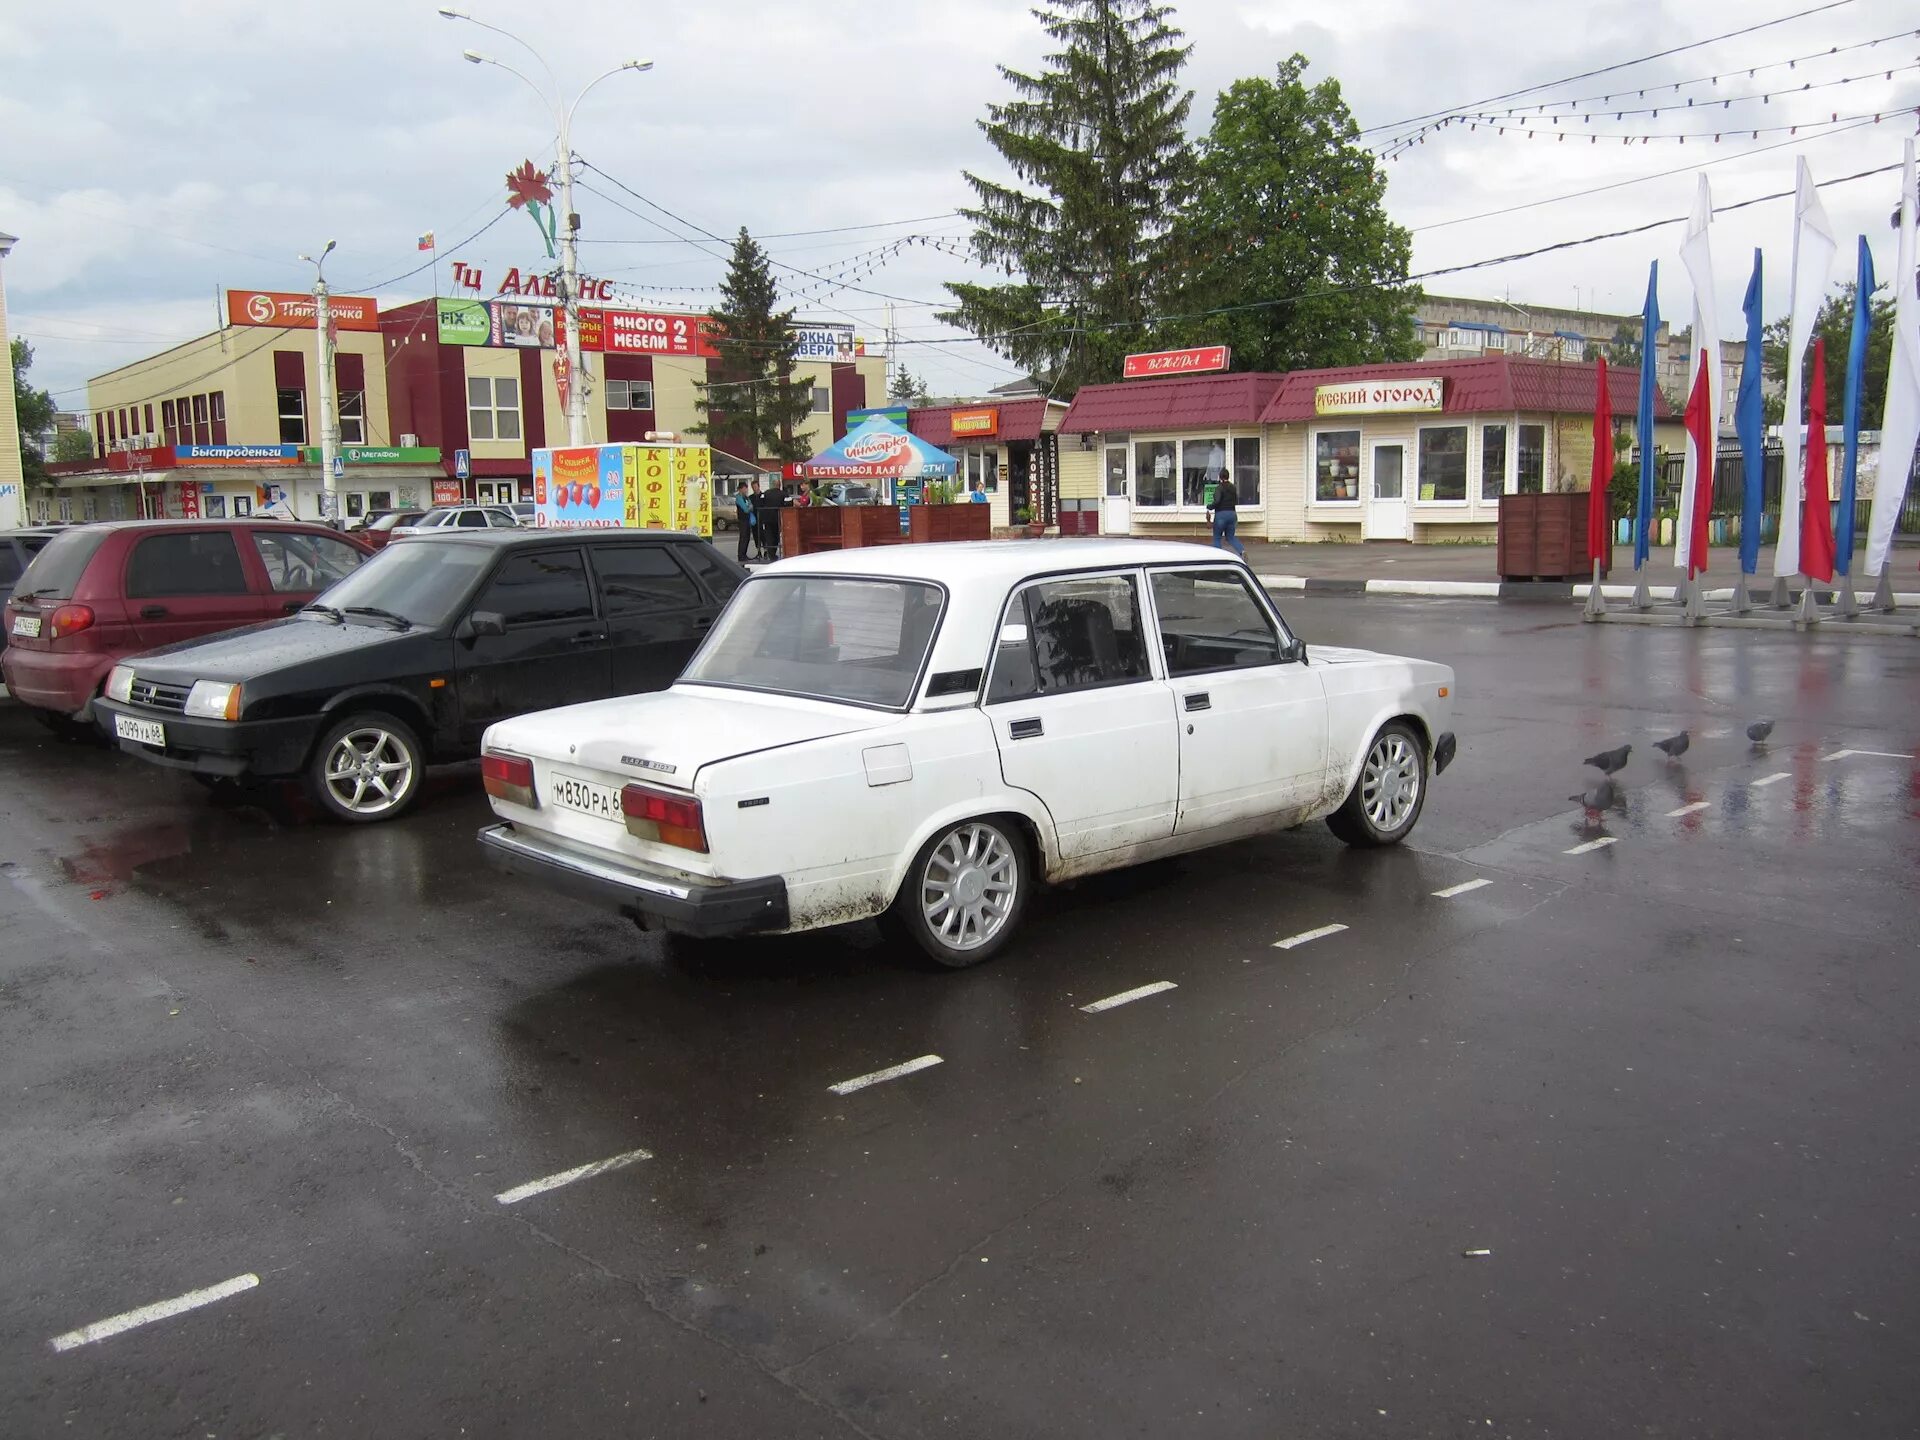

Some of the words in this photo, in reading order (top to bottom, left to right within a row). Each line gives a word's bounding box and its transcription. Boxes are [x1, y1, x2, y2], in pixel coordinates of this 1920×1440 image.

[453, 262, 483, 291] ТЦ
[497, 267, 614, 301] АЛЬНС
[440, 312, 465, 325] FIX
[613, 315, 667, 333] МНОГО
[673, 319, 688, 344] 2
[799, 331, 835, 345] ОКНА
[614, 333, 668, 349] МЕБЕЛИ
[1316, 388, 1367, 409] РУССКИЙ
[1373, 388, 1436, 405] ОГОРОД
[190, 446, 282, 459] Быстроденьги
[646, 449, 662, 509] КОФЕ
[812, 466, 838, 475] ЕСТЬ
[839, 465, 872, 475] ПОВОД
[875, 465, 896, 475] ДЛЯ
[625, 476, 636, 520] ЧАЙ
[698, 447, 709, 534] КОКТЕЙЛЬ
[118, 720, 151, 741] Н099УА
[151, 724, 161, 738] 68
[625, 757, 644, 767] LADA
[653, 762, 669, 770] 2107
[556, 780, 610, 815] М830РА
[613, 790, 623, 811] 6
